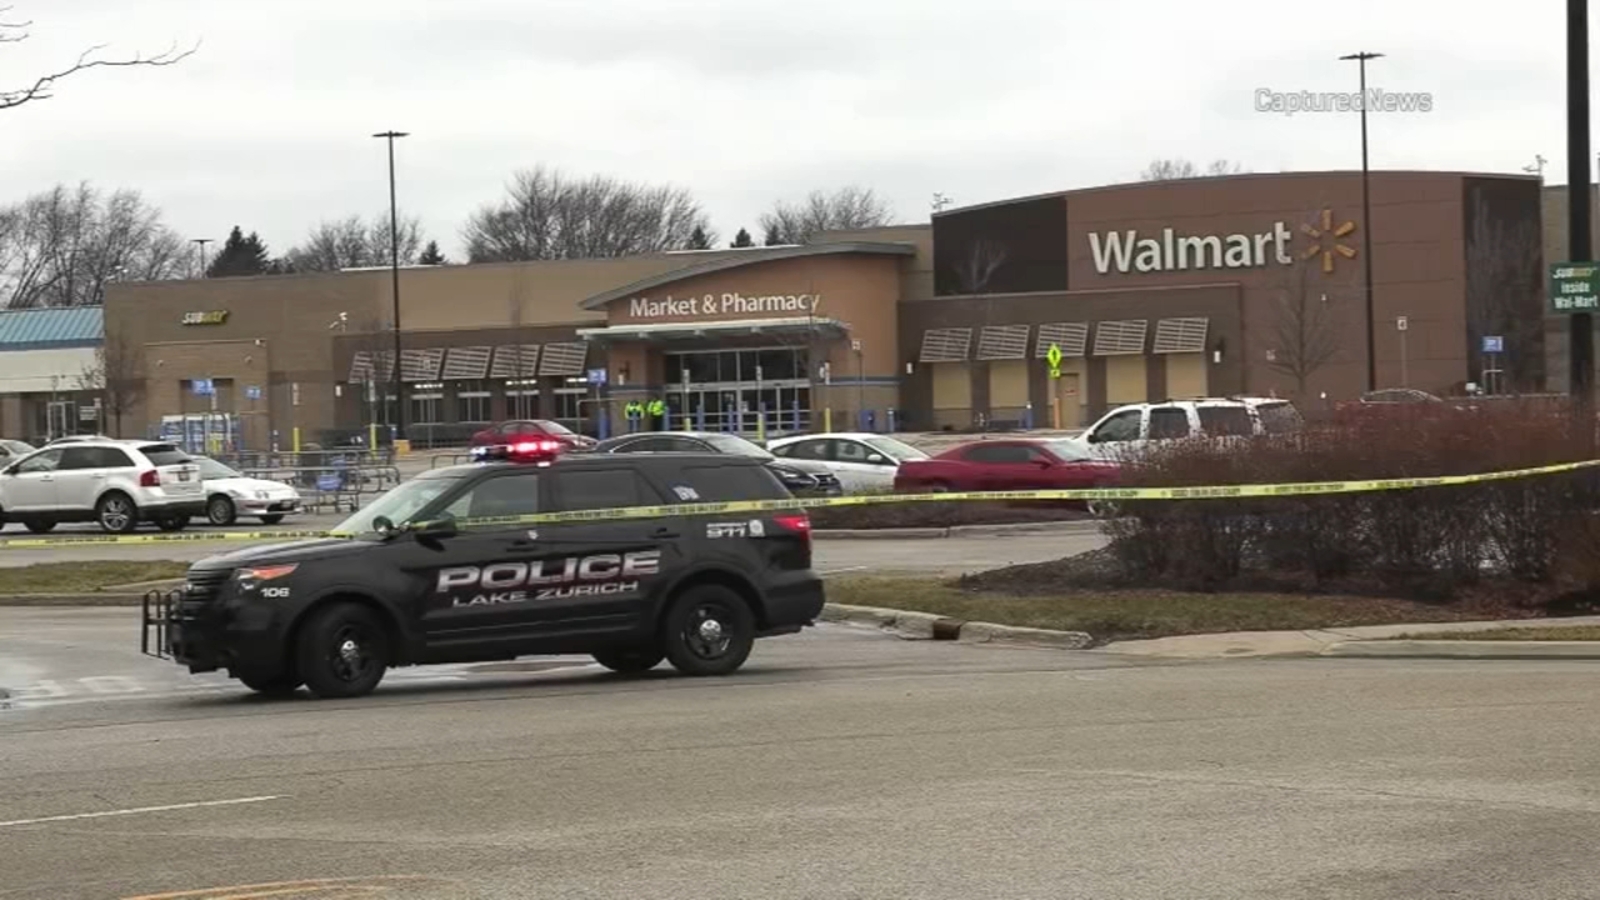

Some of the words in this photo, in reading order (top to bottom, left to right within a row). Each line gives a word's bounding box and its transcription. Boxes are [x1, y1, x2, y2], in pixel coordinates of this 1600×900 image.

[1088, 222, 1293, 274] Walmart
[630, 296, 698, 317] Market
[702, 294, 718, 314] &
[721, 292, 820, 313] Pharmacy
[436, 550, 661, 593] POLICE
[260, 587, 290, 598] 106
[452, 590, 528, 608] LAKE
[535, 581, 640, 600] ZURICH
